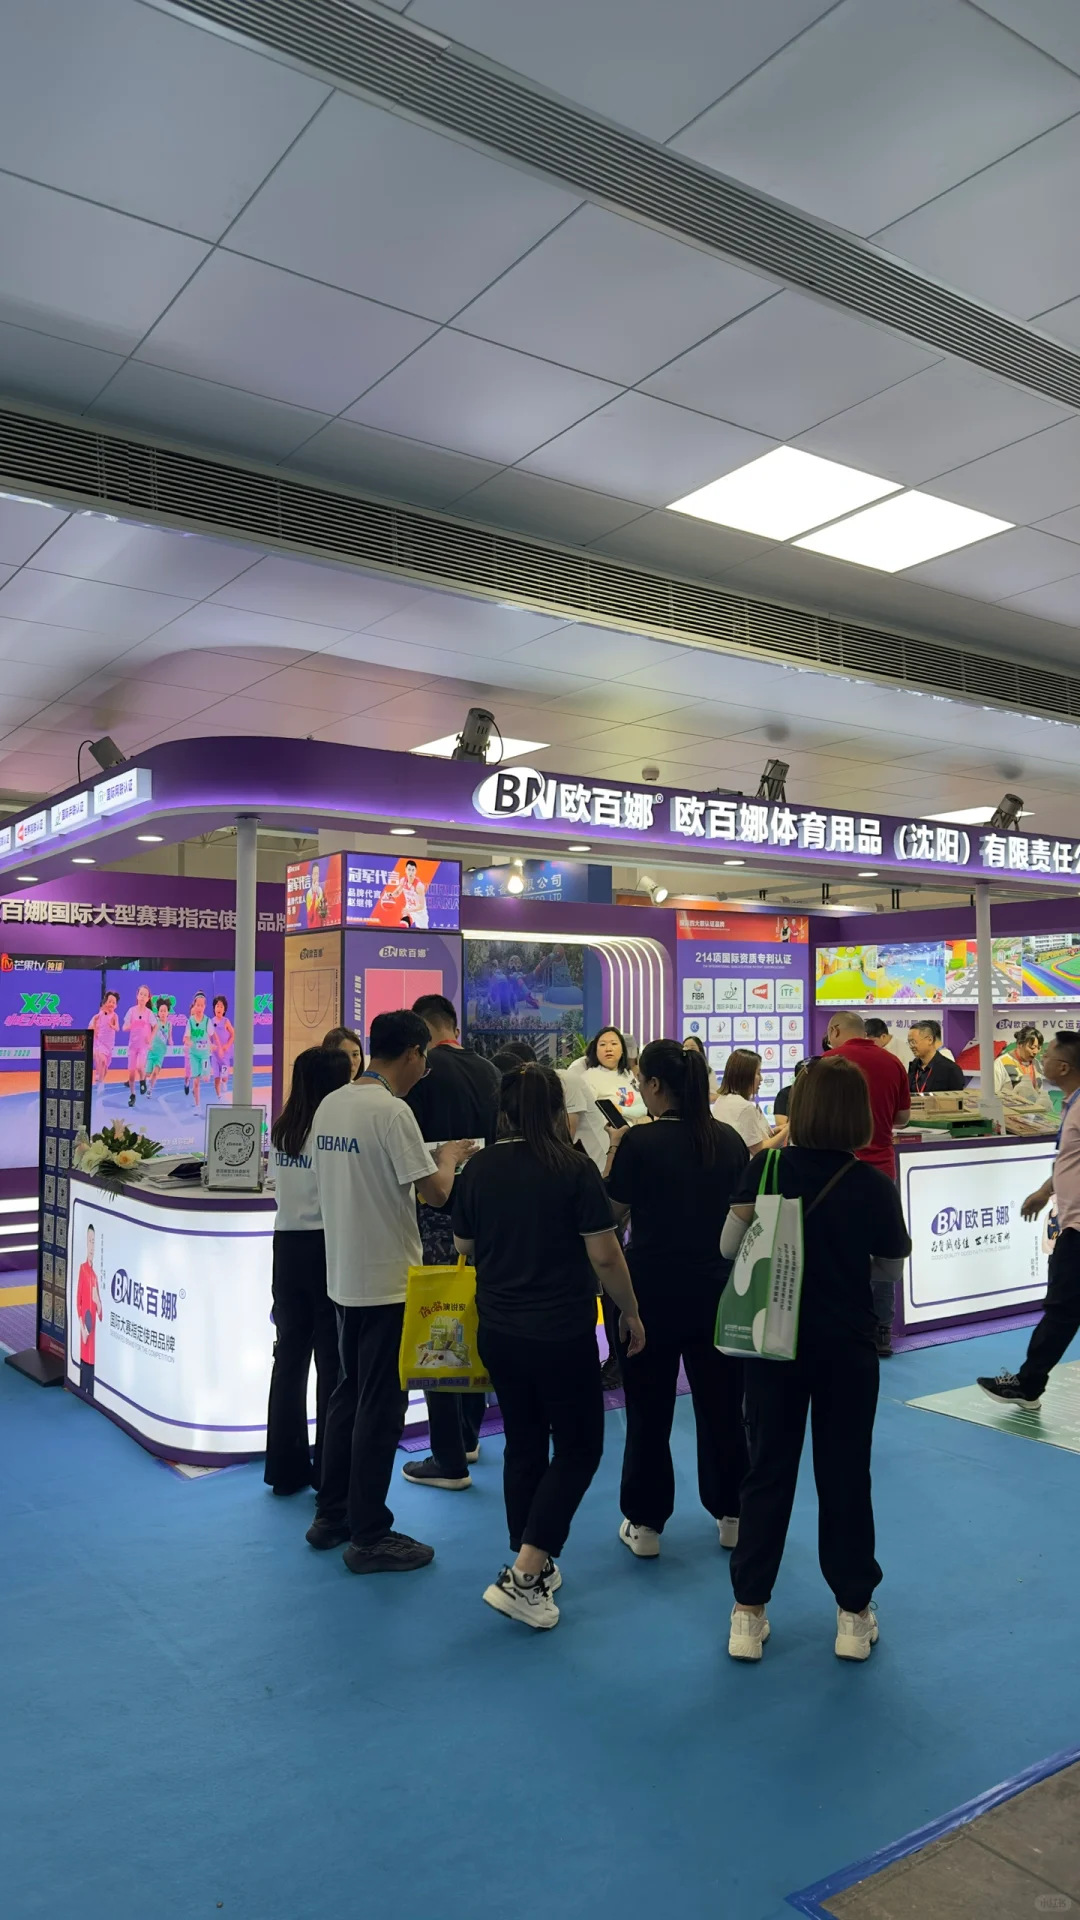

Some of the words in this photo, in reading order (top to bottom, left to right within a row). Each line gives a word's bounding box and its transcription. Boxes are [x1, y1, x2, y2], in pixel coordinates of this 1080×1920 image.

[349, 867, 400, 886] 冠军代言
[354, 975, 362, 994] FUN
[110, 1311, 176, 1353] 国际大赛指定使用品牌
